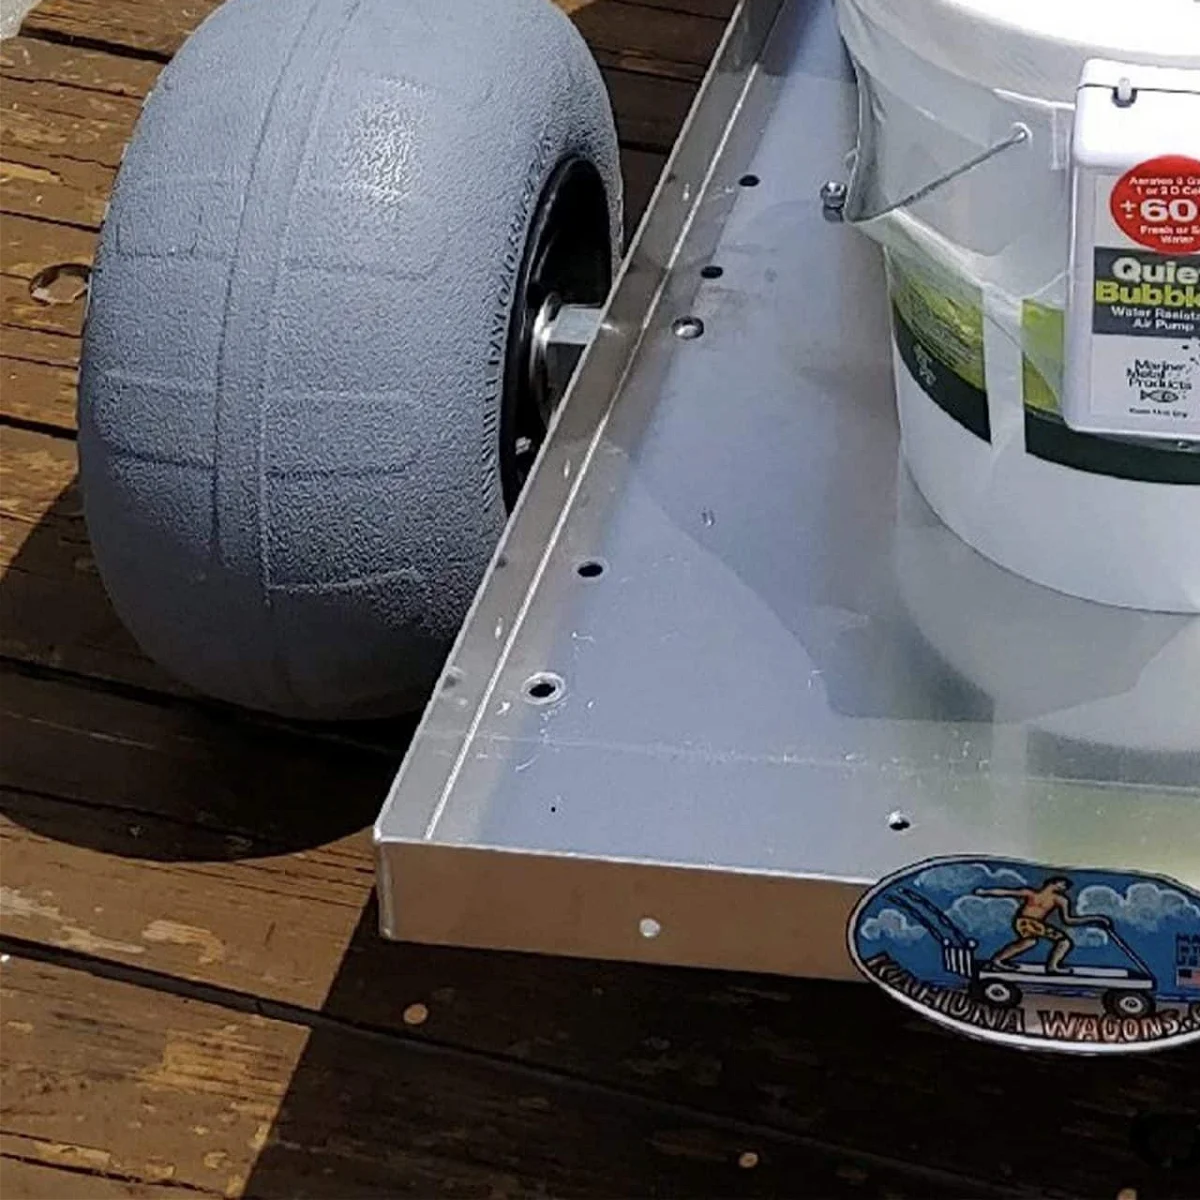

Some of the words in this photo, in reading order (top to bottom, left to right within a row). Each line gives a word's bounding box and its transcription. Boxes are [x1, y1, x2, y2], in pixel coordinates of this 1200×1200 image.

[1146, 187, 1159, 196] or
[1140, 225, 1174, 236] Fresh
[1176, 226, 1189, 235] or
[1160, 235, 1196, 245] Water
[1110, 305, 1151, 318] Water
[1132, 318, 1153, 329] Air
[1155, 319, 1195, 332] Pump
[1129, 377, 1192, 390] Products
[865, 950, 1027, 1034] KAHUNA
